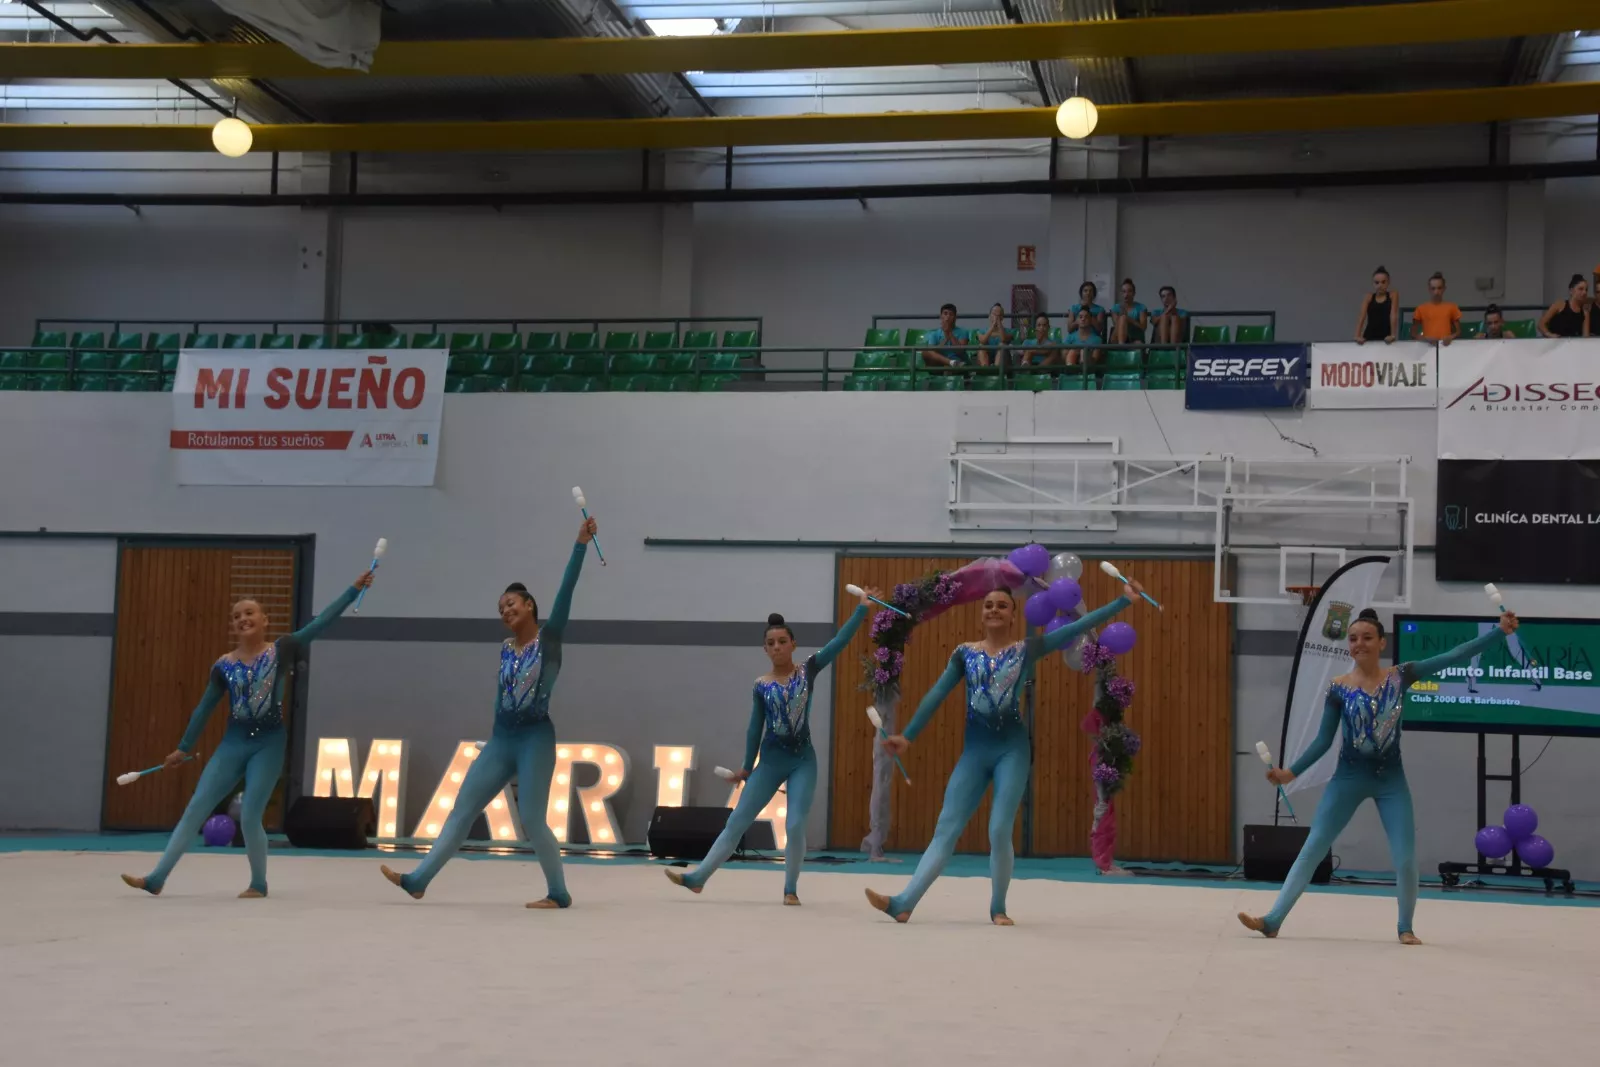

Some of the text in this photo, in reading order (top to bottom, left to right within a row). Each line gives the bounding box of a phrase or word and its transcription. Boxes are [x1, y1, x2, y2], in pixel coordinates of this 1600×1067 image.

[1193, 357, 1299, 376] SERFEY
[1321, 361, 1427, 388] MODOVIAJE
[194, 355, 426, 410] MI SUEÑO
[187, 432, 325, 448] Rotulamos tus sueños
[1475, 511, 1528, 524] CLINÍCA
[1532, 513, 1584, 524] DENTAL
[1304, 641, 1350, 656] BARBASTR
[1489, 665, 1549, 679] Infantil
[1554, 667, 1592, 680] Base
[1411, 681, 1439, 691] Gala
[1411, 695, 1521, 706] Club 2000 GR Barbastro
